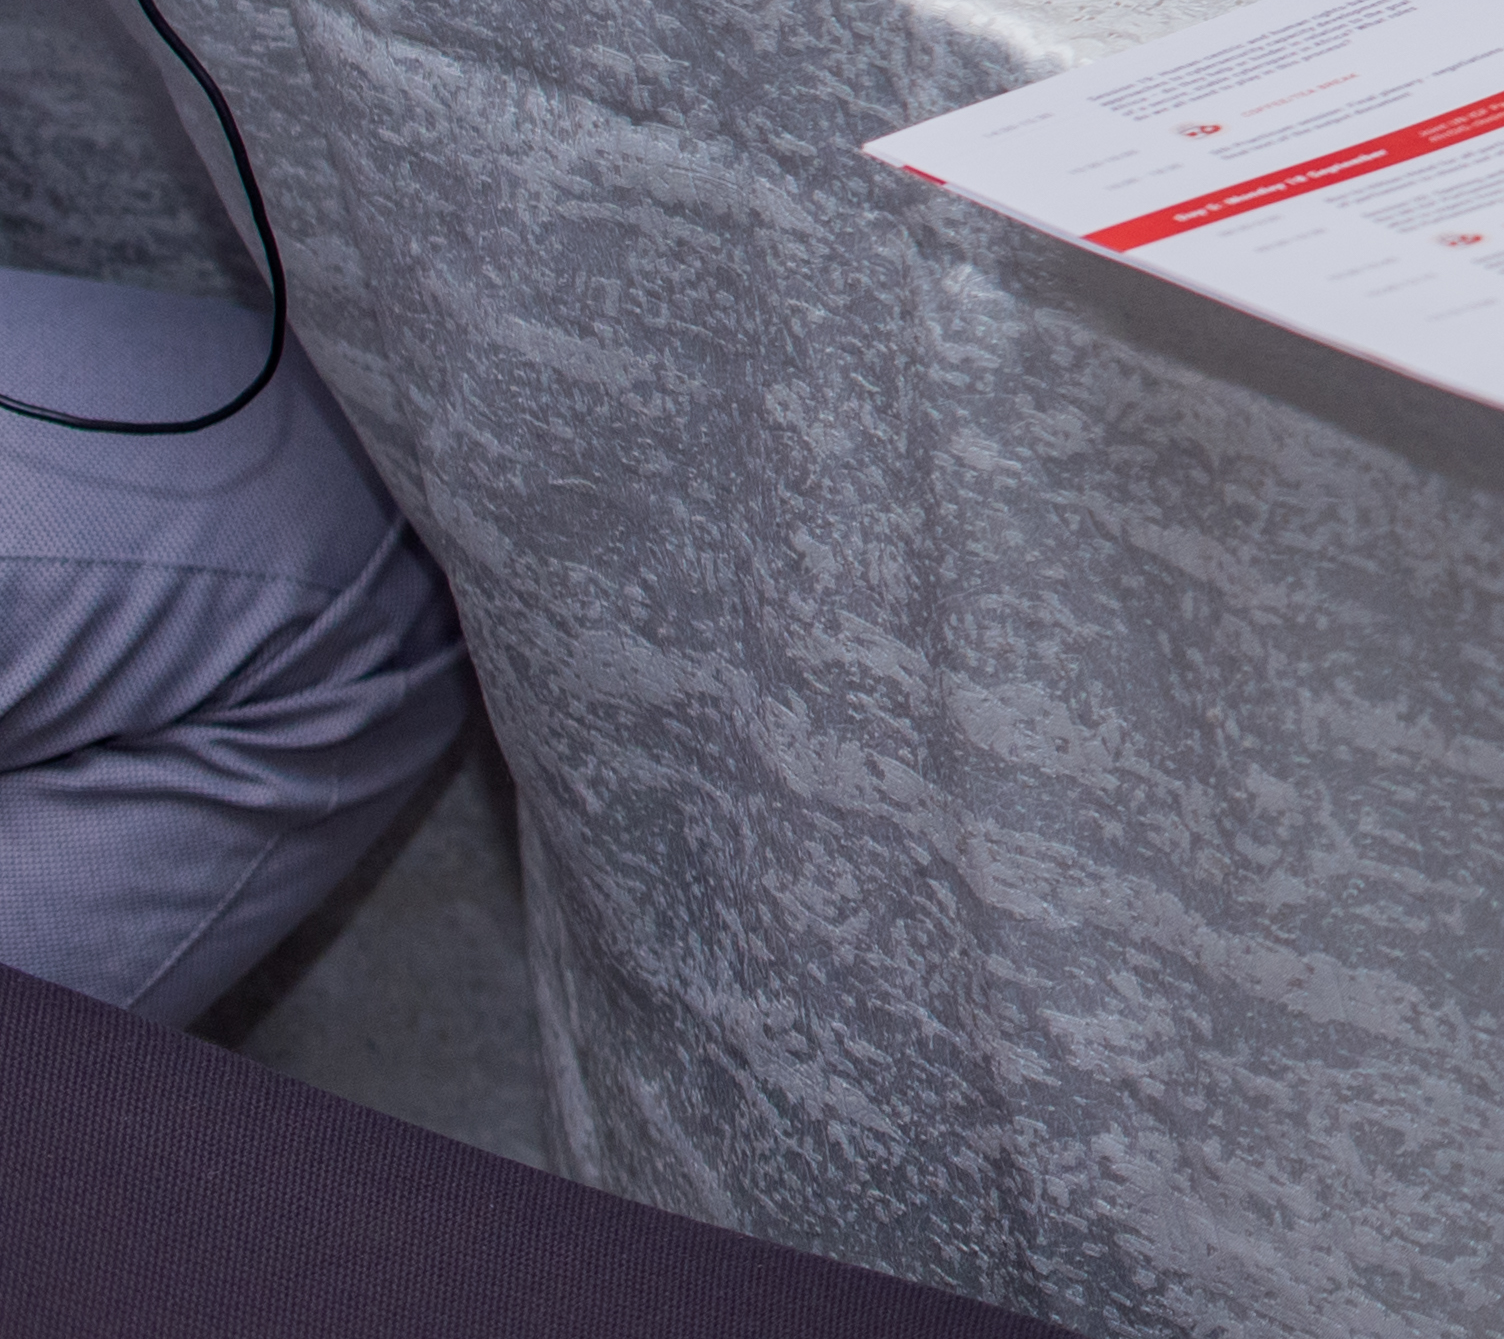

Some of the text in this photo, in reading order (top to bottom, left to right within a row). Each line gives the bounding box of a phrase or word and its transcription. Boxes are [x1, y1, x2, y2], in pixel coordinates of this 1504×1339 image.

[1316, 72, 1359, 91] BREAK
[1223, 182, 1286, 207] Monday
[1305, 149, 1387, 178] September
